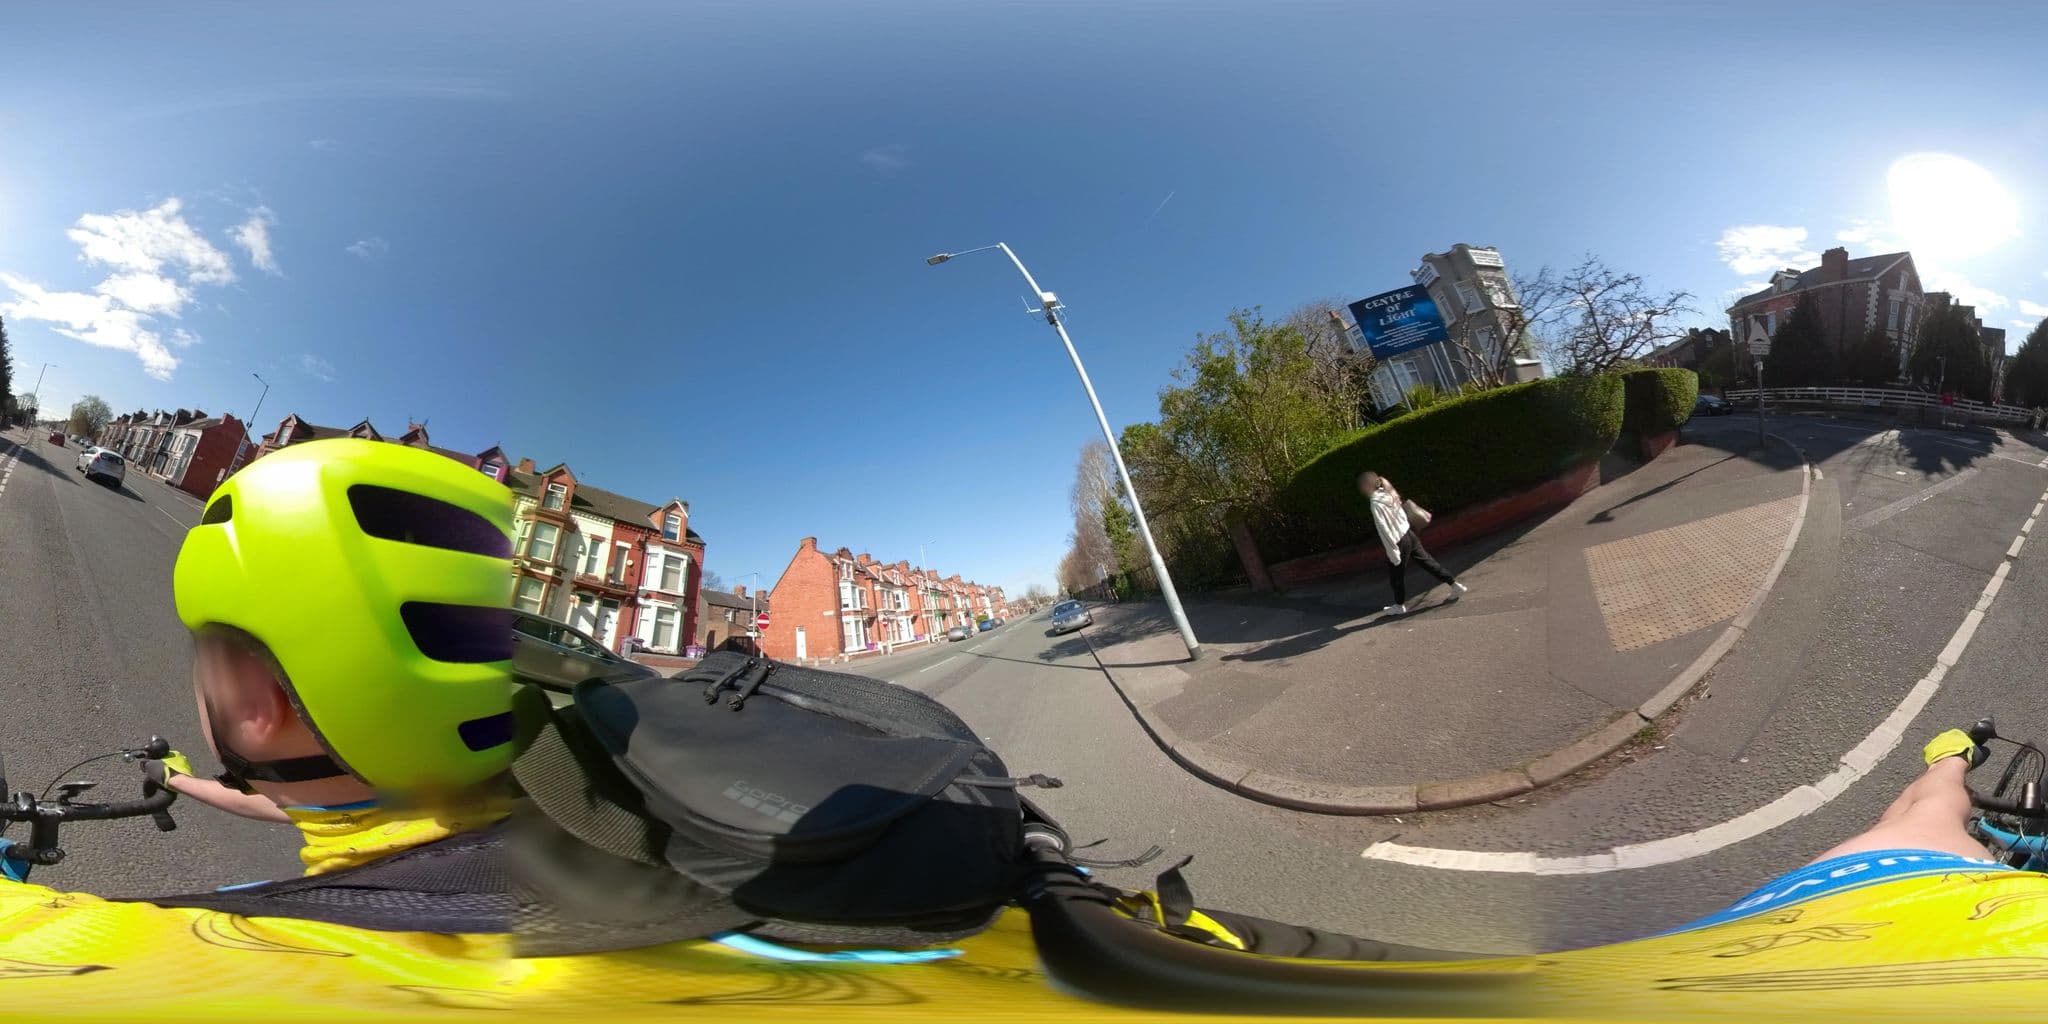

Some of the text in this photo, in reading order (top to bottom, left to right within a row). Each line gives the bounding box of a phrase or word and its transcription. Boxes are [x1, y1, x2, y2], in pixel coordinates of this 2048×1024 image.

[1365, 290, 1414, 310] CENTRE
[1386, 303, 1401, 313] OF
[1379, 309, 1416, 326] LIGHT
